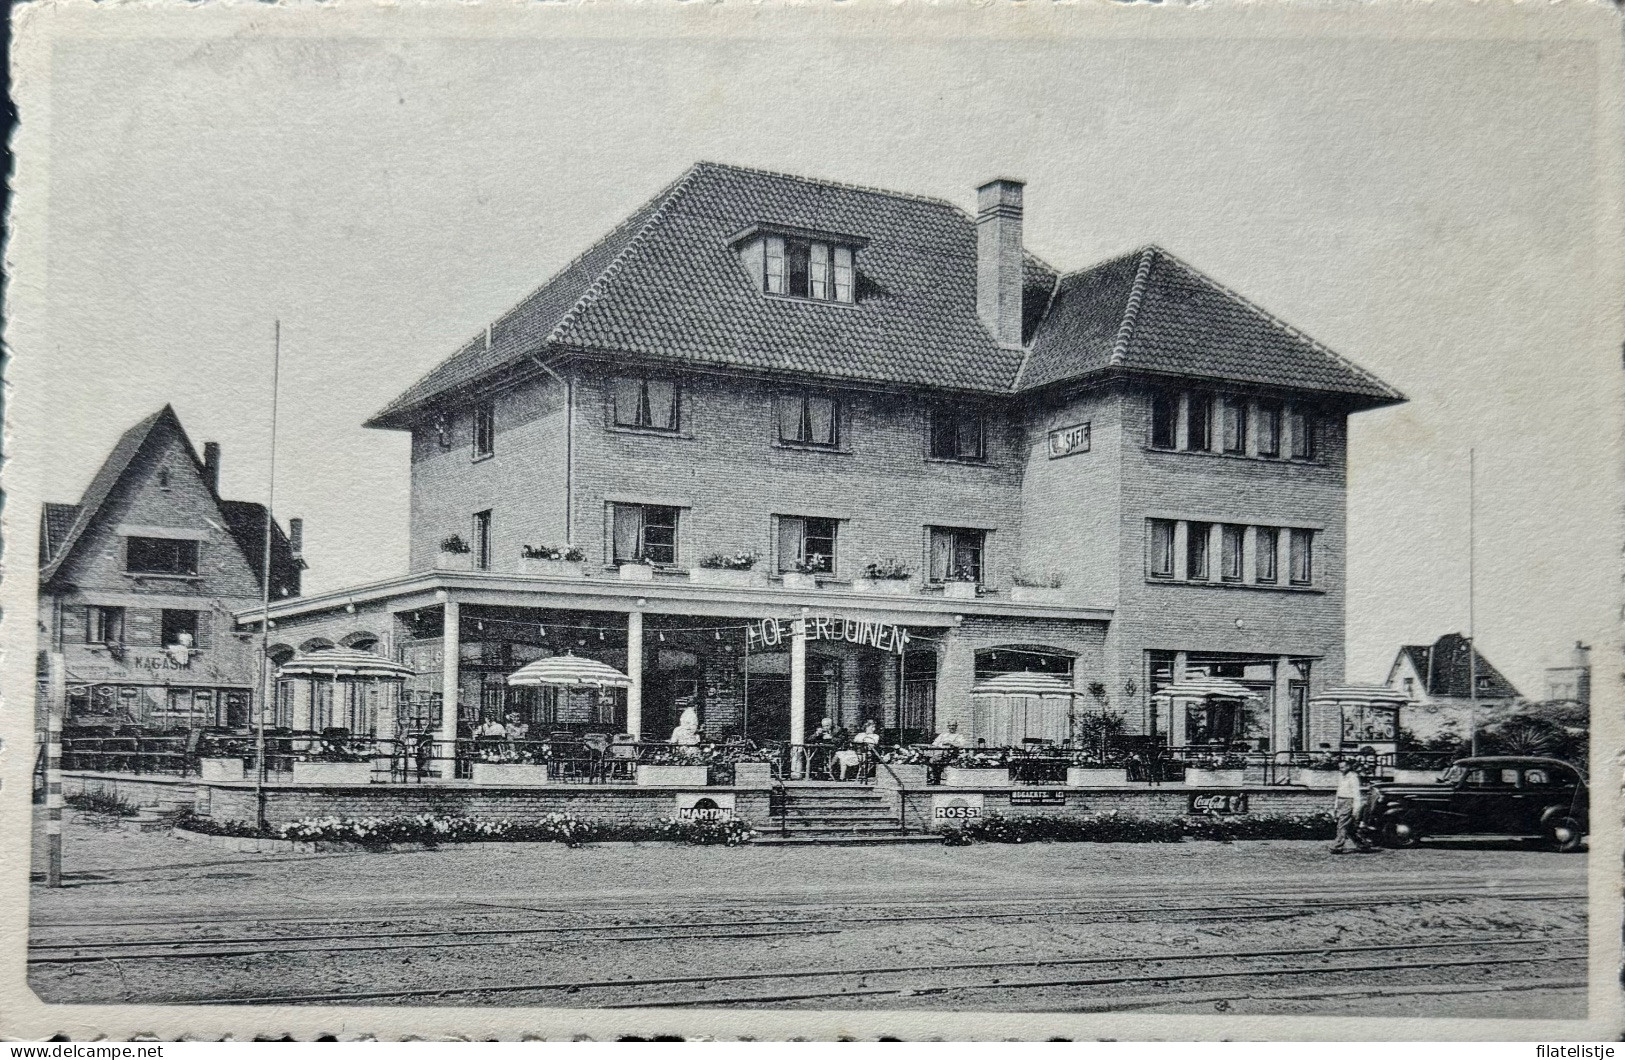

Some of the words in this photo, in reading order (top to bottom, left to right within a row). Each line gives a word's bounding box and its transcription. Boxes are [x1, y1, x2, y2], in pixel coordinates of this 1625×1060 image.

[748, 616, 786, 649] HOF
[681, 808, 731, 820] MARTINI
[936, 807, 981, 818] ROSSI
